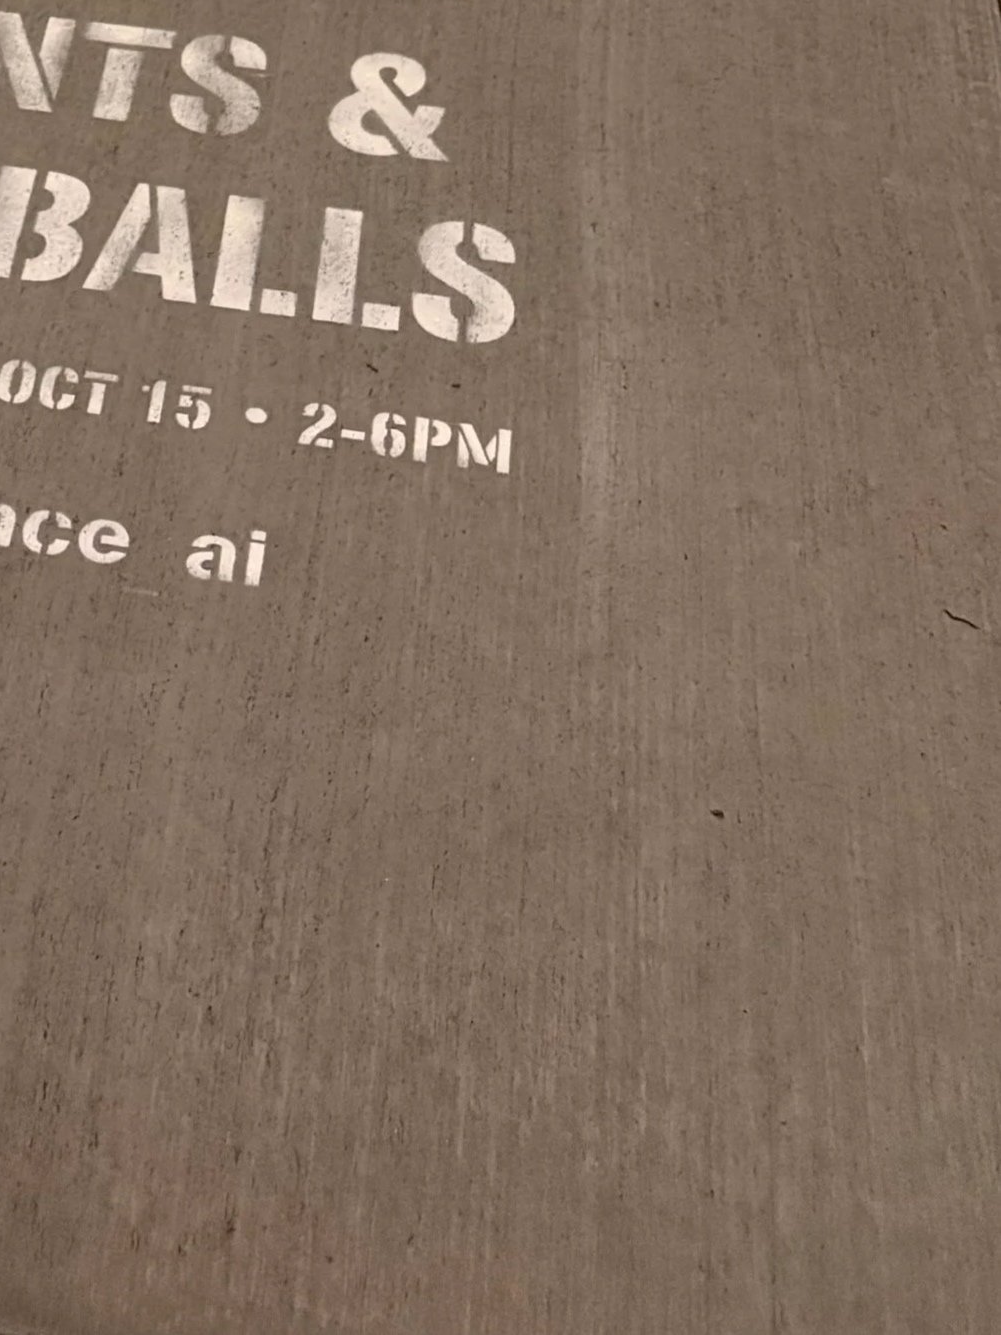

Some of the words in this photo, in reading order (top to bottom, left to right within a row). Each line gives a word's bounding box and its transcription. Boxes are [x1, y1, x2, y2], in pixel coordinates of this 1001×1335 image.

[328, 52, 449, 162] &
[142, 379, 212, 431] 15
[296, 401, 514, 475] 2-6PM
[185, 529, 268, 588] ai
